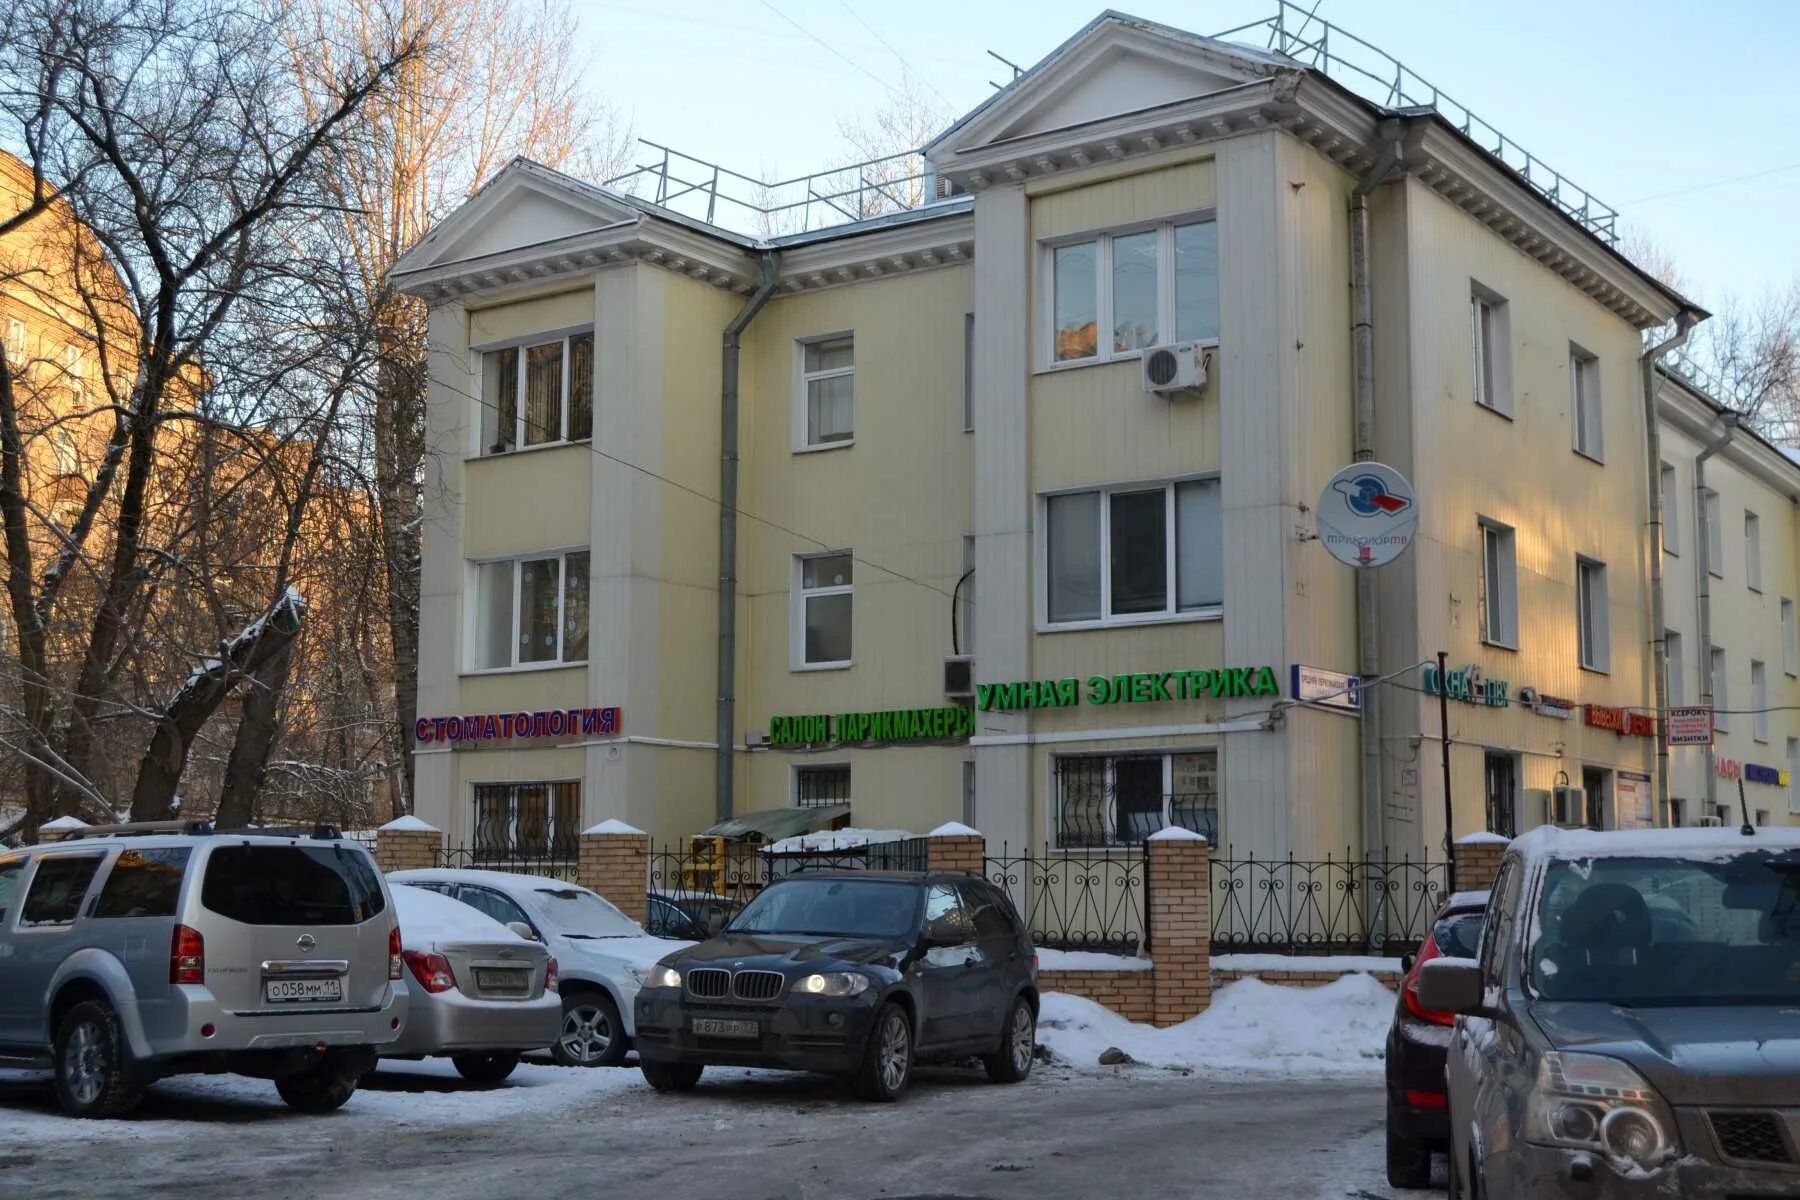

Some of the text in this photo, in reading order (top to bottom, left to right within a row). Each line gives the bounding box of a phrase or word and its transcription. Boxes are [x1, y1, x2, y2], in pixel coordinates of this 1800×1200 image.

[976, 666, 1279, 712] УМНАЯ ЭЛЕКТРИКА
[415, 705, 621, 744] СТОМАТОЛОГИЯ
[769, 714, 829, 744] САЛОН
